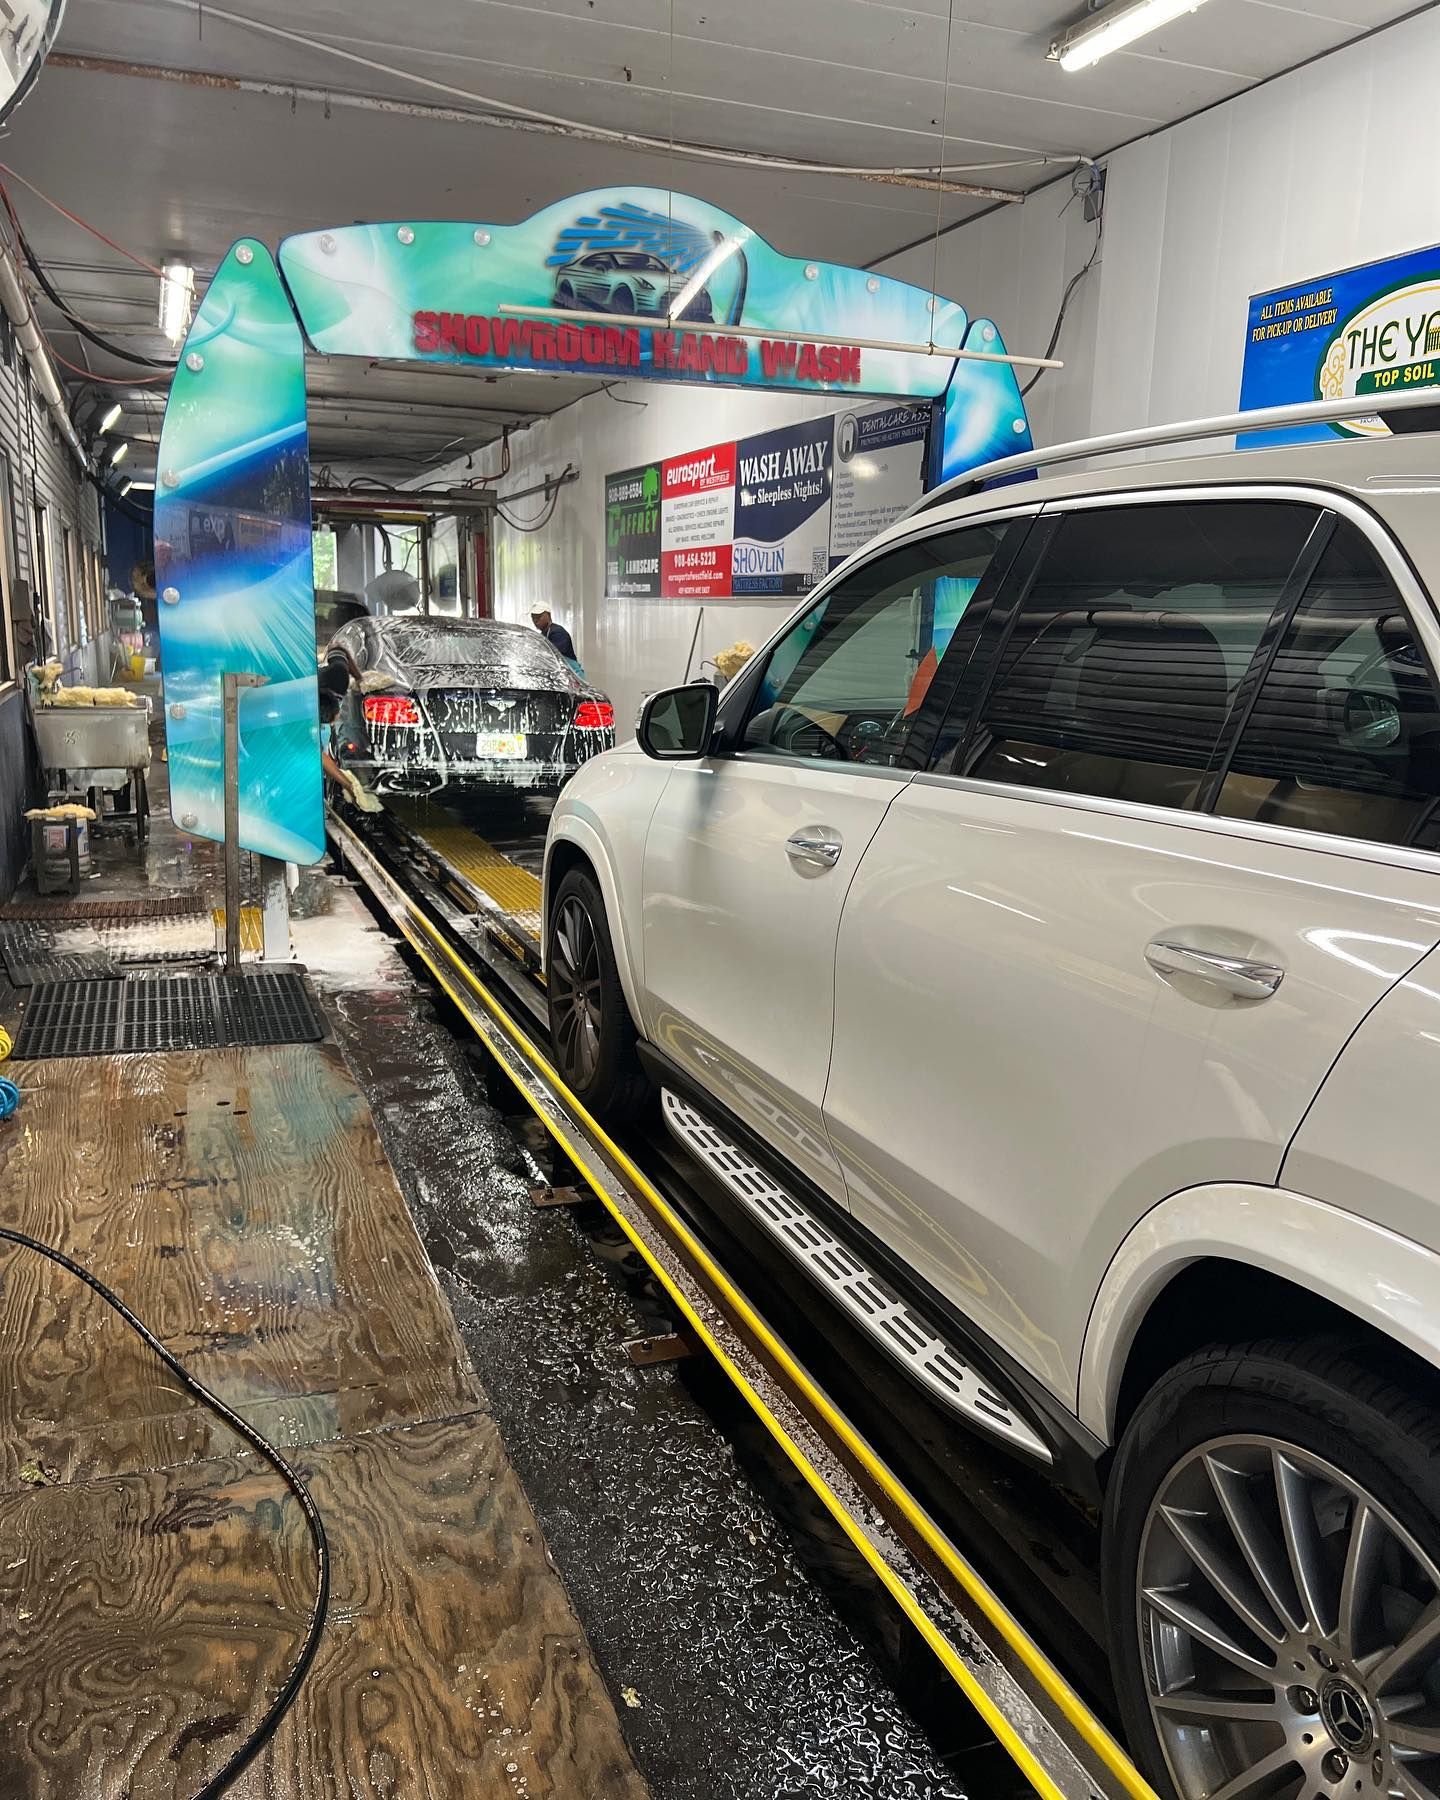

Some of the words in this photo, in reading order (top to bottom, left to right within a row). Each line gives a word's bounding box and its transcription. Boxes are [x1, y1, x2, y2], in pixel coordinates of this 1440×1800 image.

[1261, 305, 1273, 320] ALL
[1274, 299, 1295, 316] ITEMS
[1295, 289, 1332, 311] AVAILABLE
[1252, 326, 1266, 342] FOR
[1266, 320, 1292, 339] PICK-UP
[1293, 317, 1304, 332] OR
[1305, 309, 1337, 330] DELIVERY
[415, 311, 640, 367] SHOWROOM
[652, 331, 747, 374] HAND
[760, 340, 860, 383] WASH
[1347, 321, 1400, 369] THE
[1374, 369, 1399, 388] TOP
[1403, 363, 1435, 383] SOIL
[667, 453, 716, 487] eurosport
[740, 452, 781, 487] WASH
[782, 441, 828, 478] AWAY
[740, 491, 757, 507] Yur
[757, 485, 792, 507] Sleepless
[792, 477, 823, 502] Nights!
[625, 558, 659, 574] LANDSCAPE
[674, 551, 717, 568] 908-654-5228
[733, 547, 785, 574] SHOVLIN
